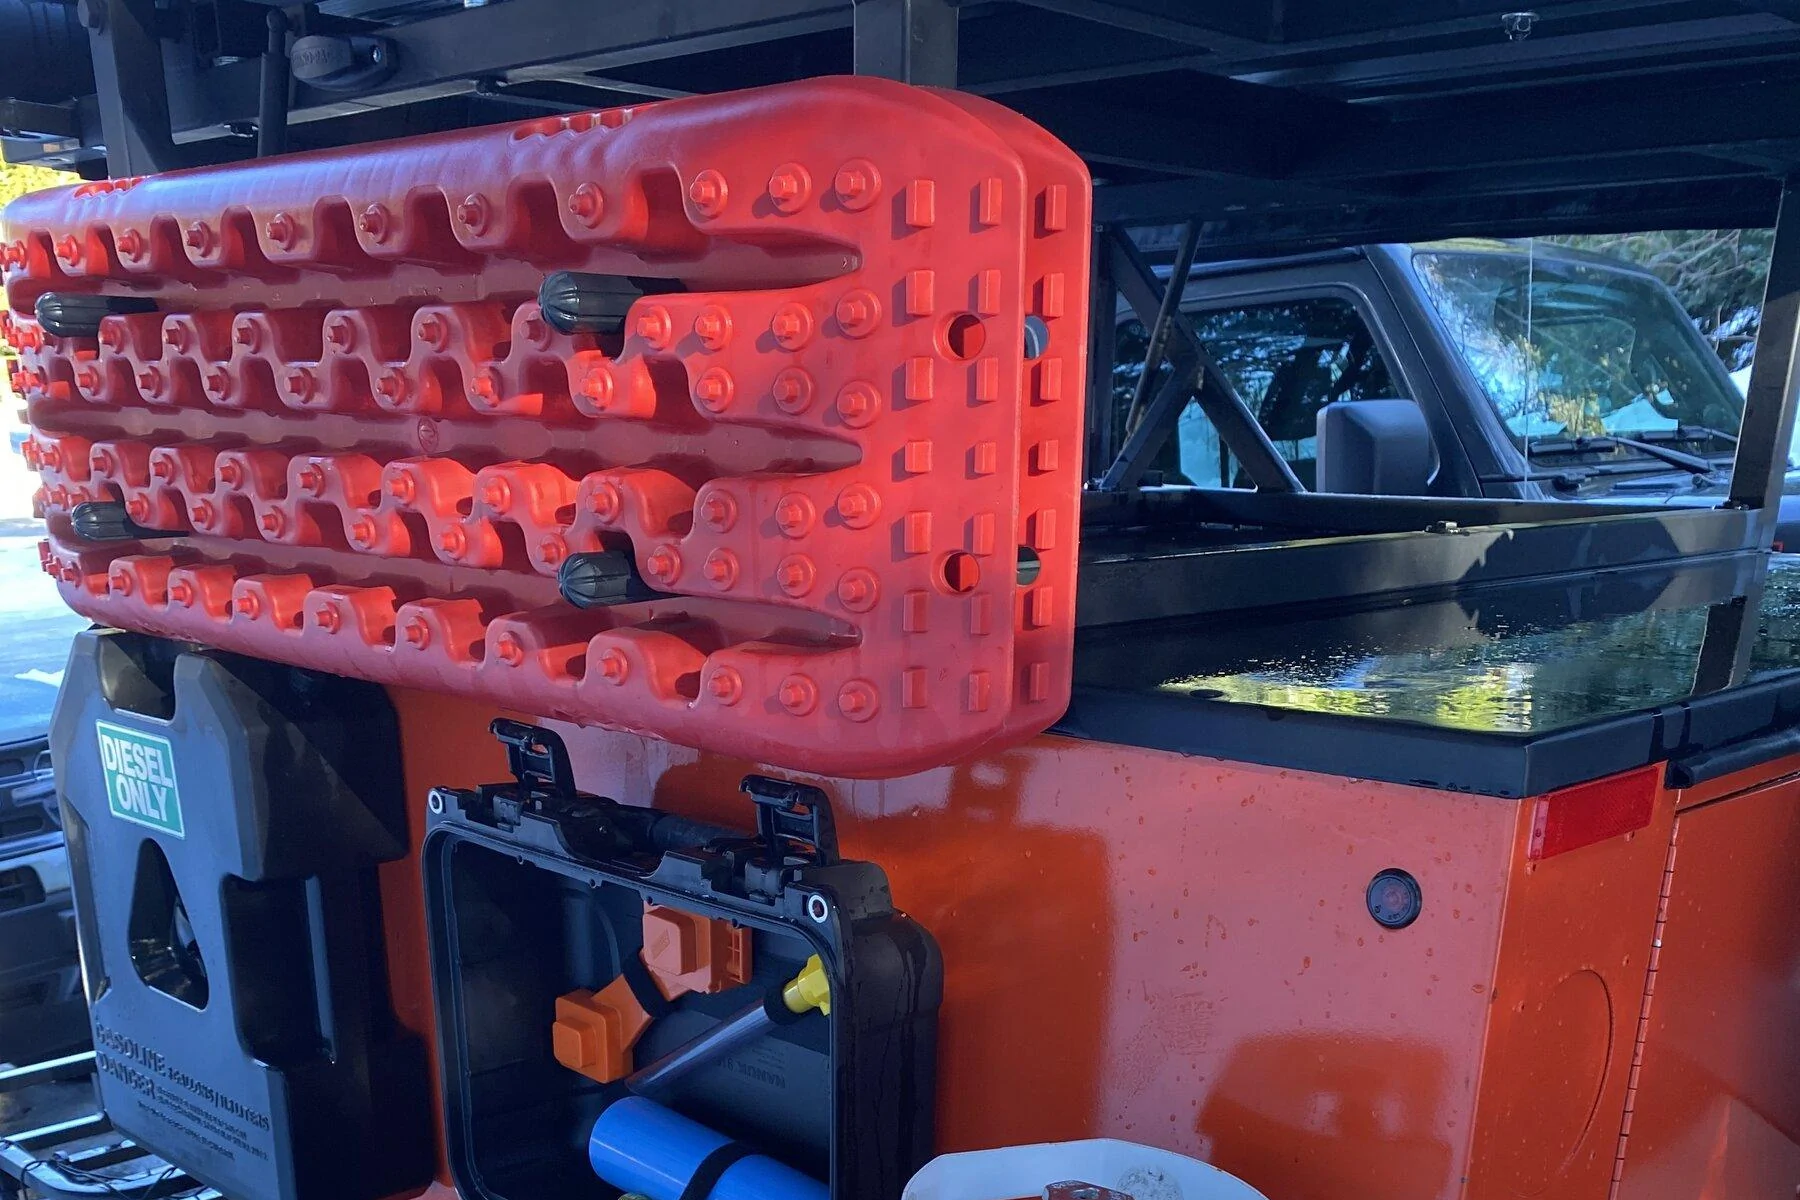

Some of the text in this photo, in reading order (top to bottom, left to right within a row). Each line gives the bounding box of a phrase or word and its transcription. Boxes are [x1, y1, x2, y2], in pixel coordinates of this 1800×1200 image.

[102, 735, 174, 788] DIESEL
[116, 774, 168, 822] ONLY
[95, 1022, 166, 1077] GASOLINE
[97, 1051, 156, 1100] DANGER
